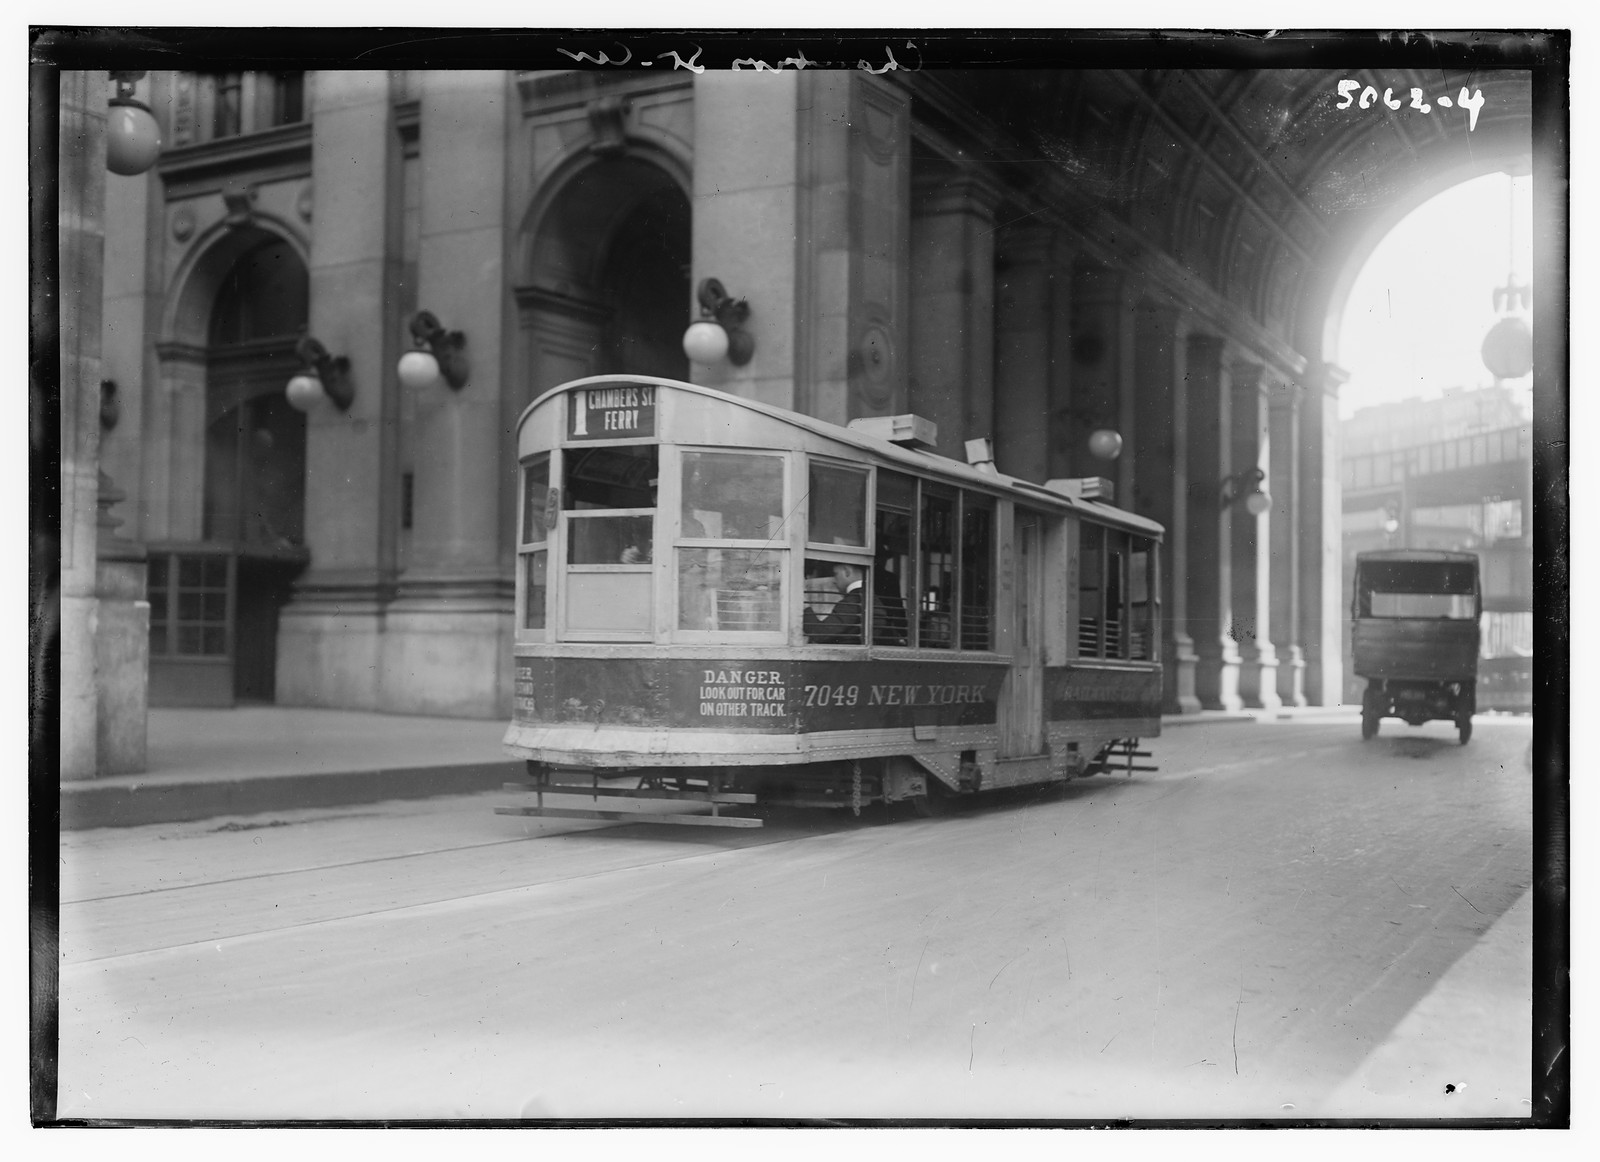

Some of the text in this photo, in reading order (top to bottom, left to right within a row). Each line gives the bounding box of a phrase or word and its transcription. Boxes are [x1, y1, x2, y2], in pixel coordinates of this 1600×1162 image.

[588, 387, 639, 410] CHAMBERS
[573, 391, 588, 435] 1
[604, 410, 639, 430] FERRY
[700, 686, 786, 700] LOOK OUT FOR CAR
[804, 685, 859, 706] 7049
[868, 684, 987, 706] NEW YORK
[700, 702, 714, 716] ON
[715, 702, 748, 717] OTHER
